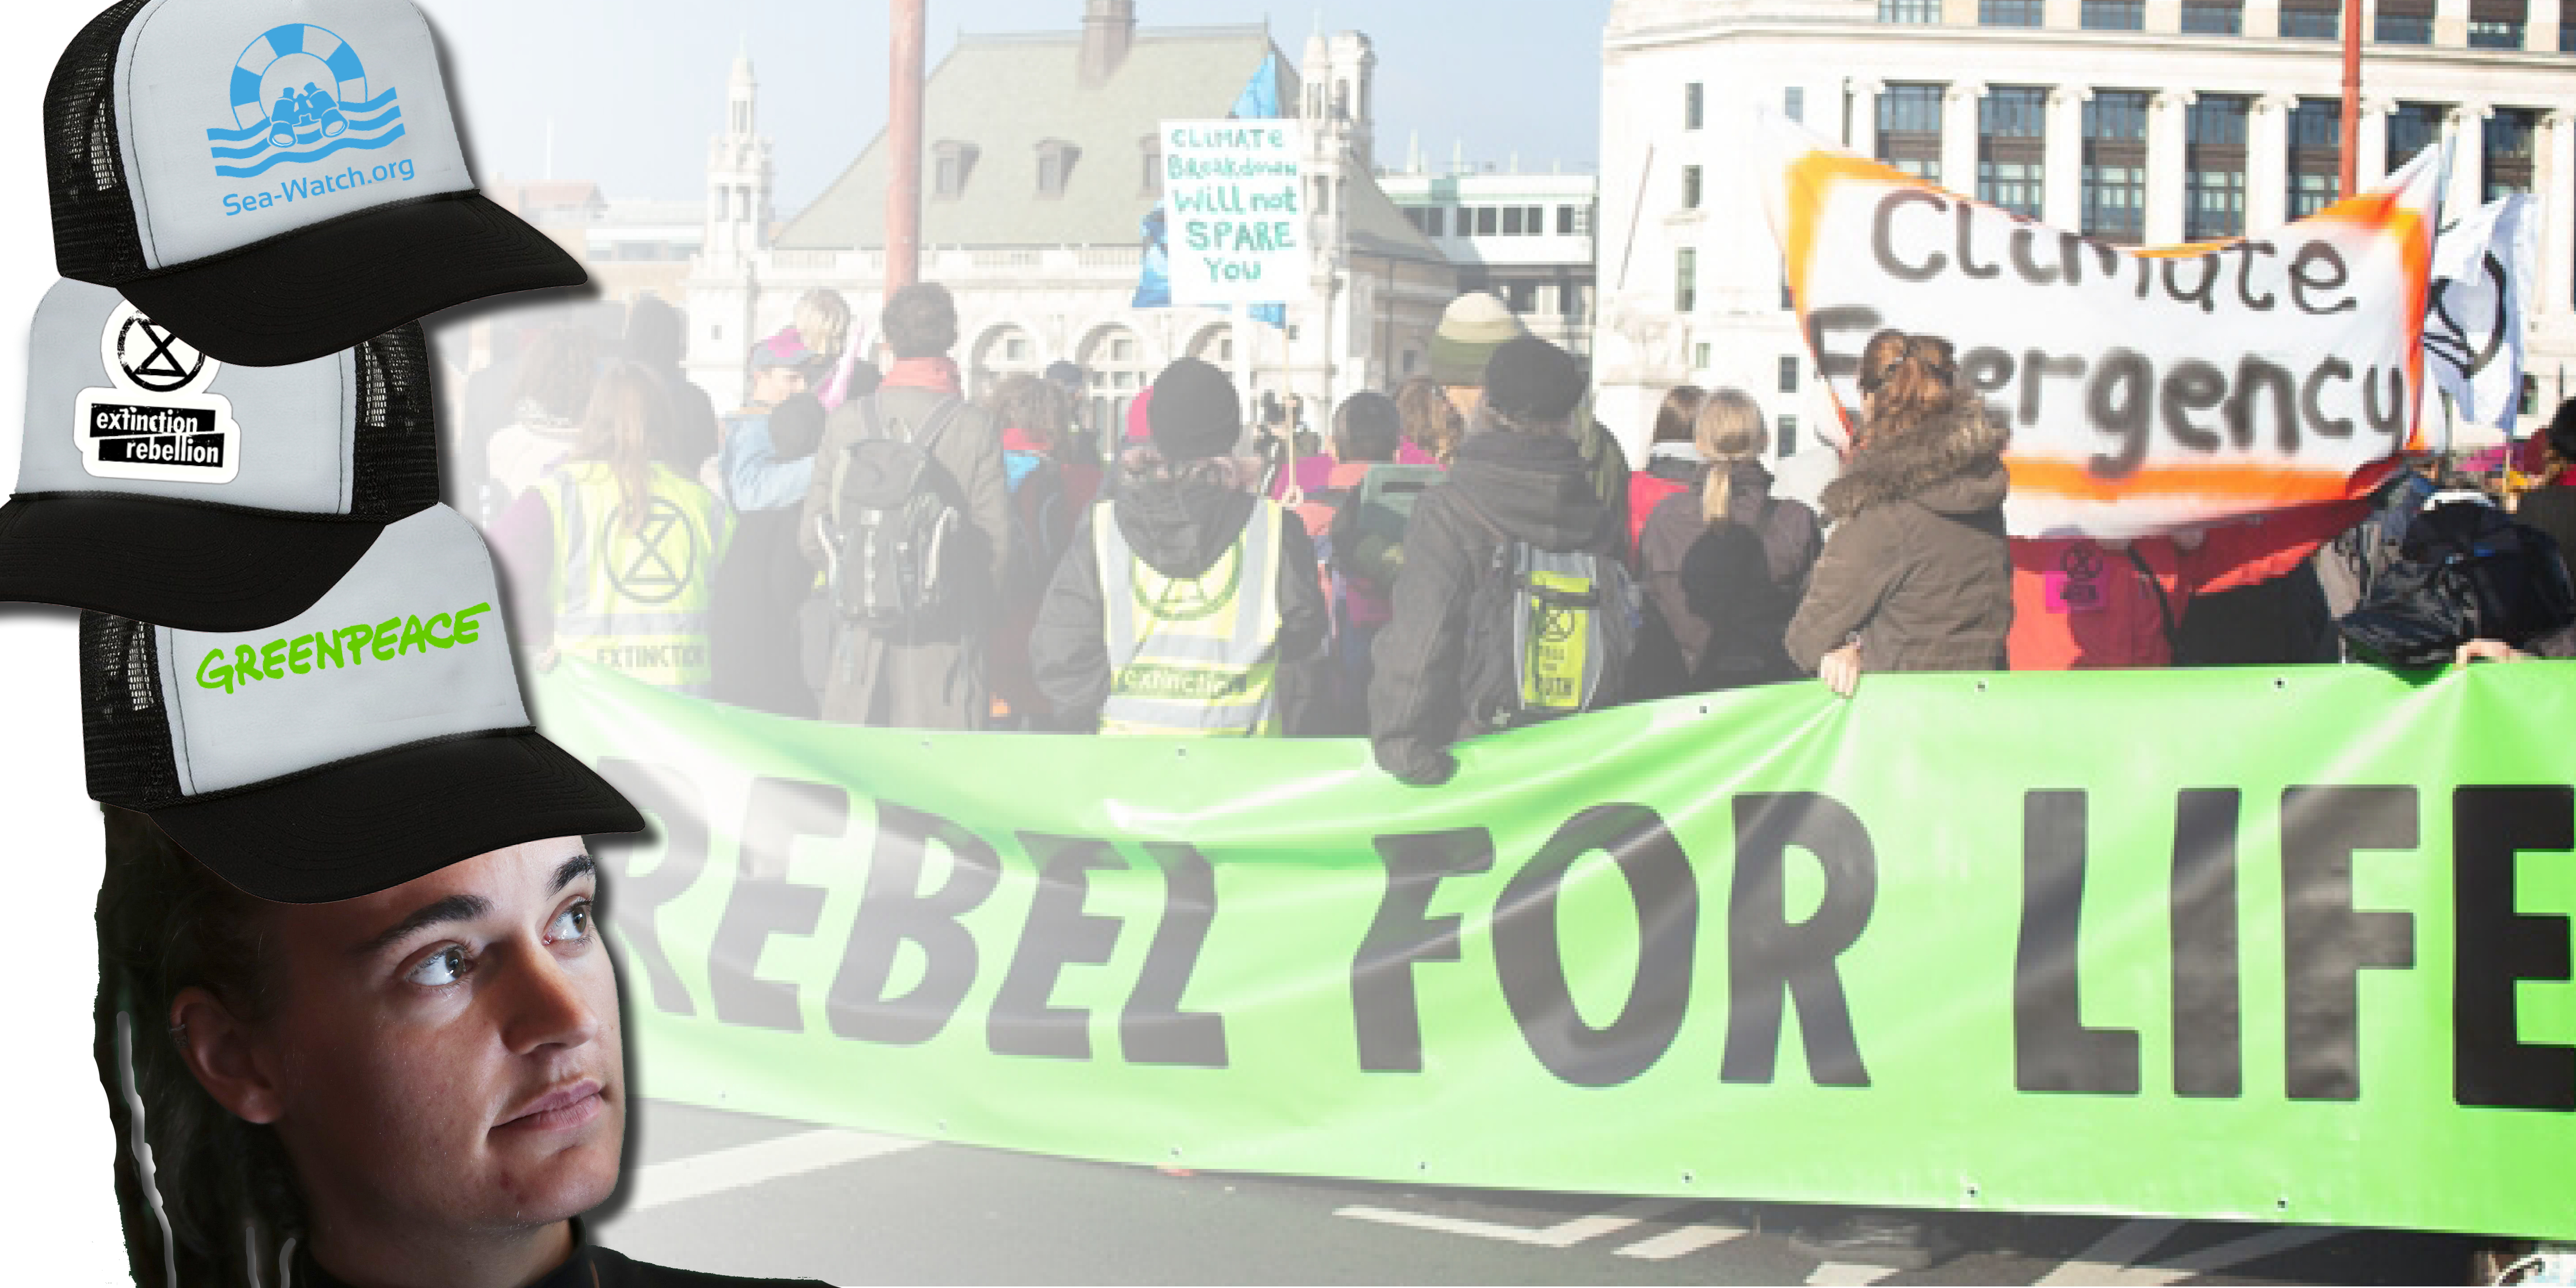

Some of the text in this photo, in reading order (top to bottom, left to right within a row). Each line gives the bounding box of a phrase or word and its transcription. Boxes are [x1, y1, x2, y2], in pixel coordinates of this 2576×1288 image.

[222, 158, 415, 216] Sea-Watch.org
[1185, 219, 1296, 251] SPARE
[96, 406, 198, 433] extinction
[1806, 306, 2404, 481] Eergency
[126, 434, 219, 463] rebellion
[196, 602, 491, 694] GREENPEACE
[596, 754, 2576, 1112] REBEL FOR LIFE
